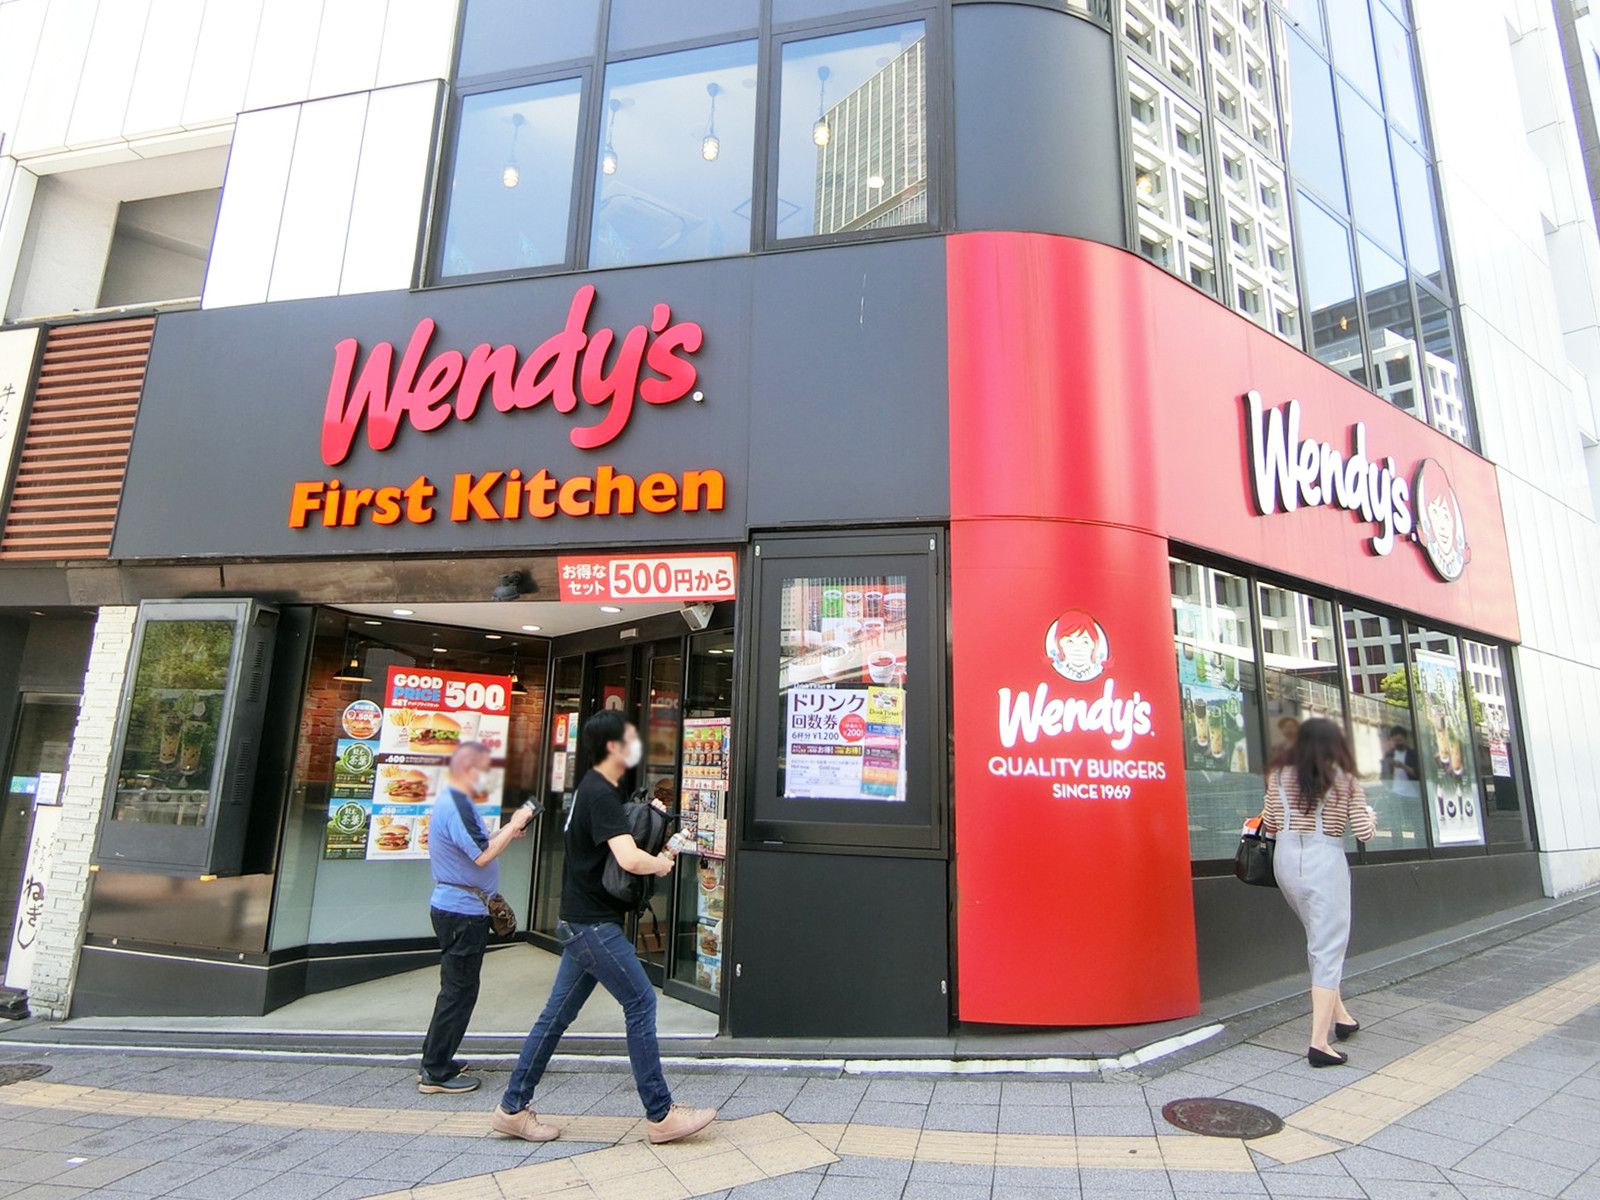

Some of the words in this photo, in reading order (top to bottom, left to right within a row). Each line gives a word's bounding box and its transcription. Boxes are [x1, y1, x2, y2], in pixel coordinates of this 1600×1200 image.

[321, 284, 703, 466] Wendy's
[1244, 390, 1412, 556] Wendy's
[288, 475, 435, 528] First
[450, 465, 725, 522] Kitchen
[562, 563, 607, 579] お得な
[613, 561, 732, 595] 500円から
[568, 581, 605, 596] セット
[393, 673, 443, 689] GOOD
[391, 698, 408, 707] SET
[393, 686, 441, 702] PRICE
[794, 693, 865, 713] ドリンク
[792, 714, 838, 730] 回数券
[998, 678, 1151, 750] Wendy's
[988, 756, 1084, 778] QUALITY
[1087, 758, 1166, 779] BURGERS
[1052, 783, 1098, 799] SINCE
[1100, 784, 1131, 799] 1969
